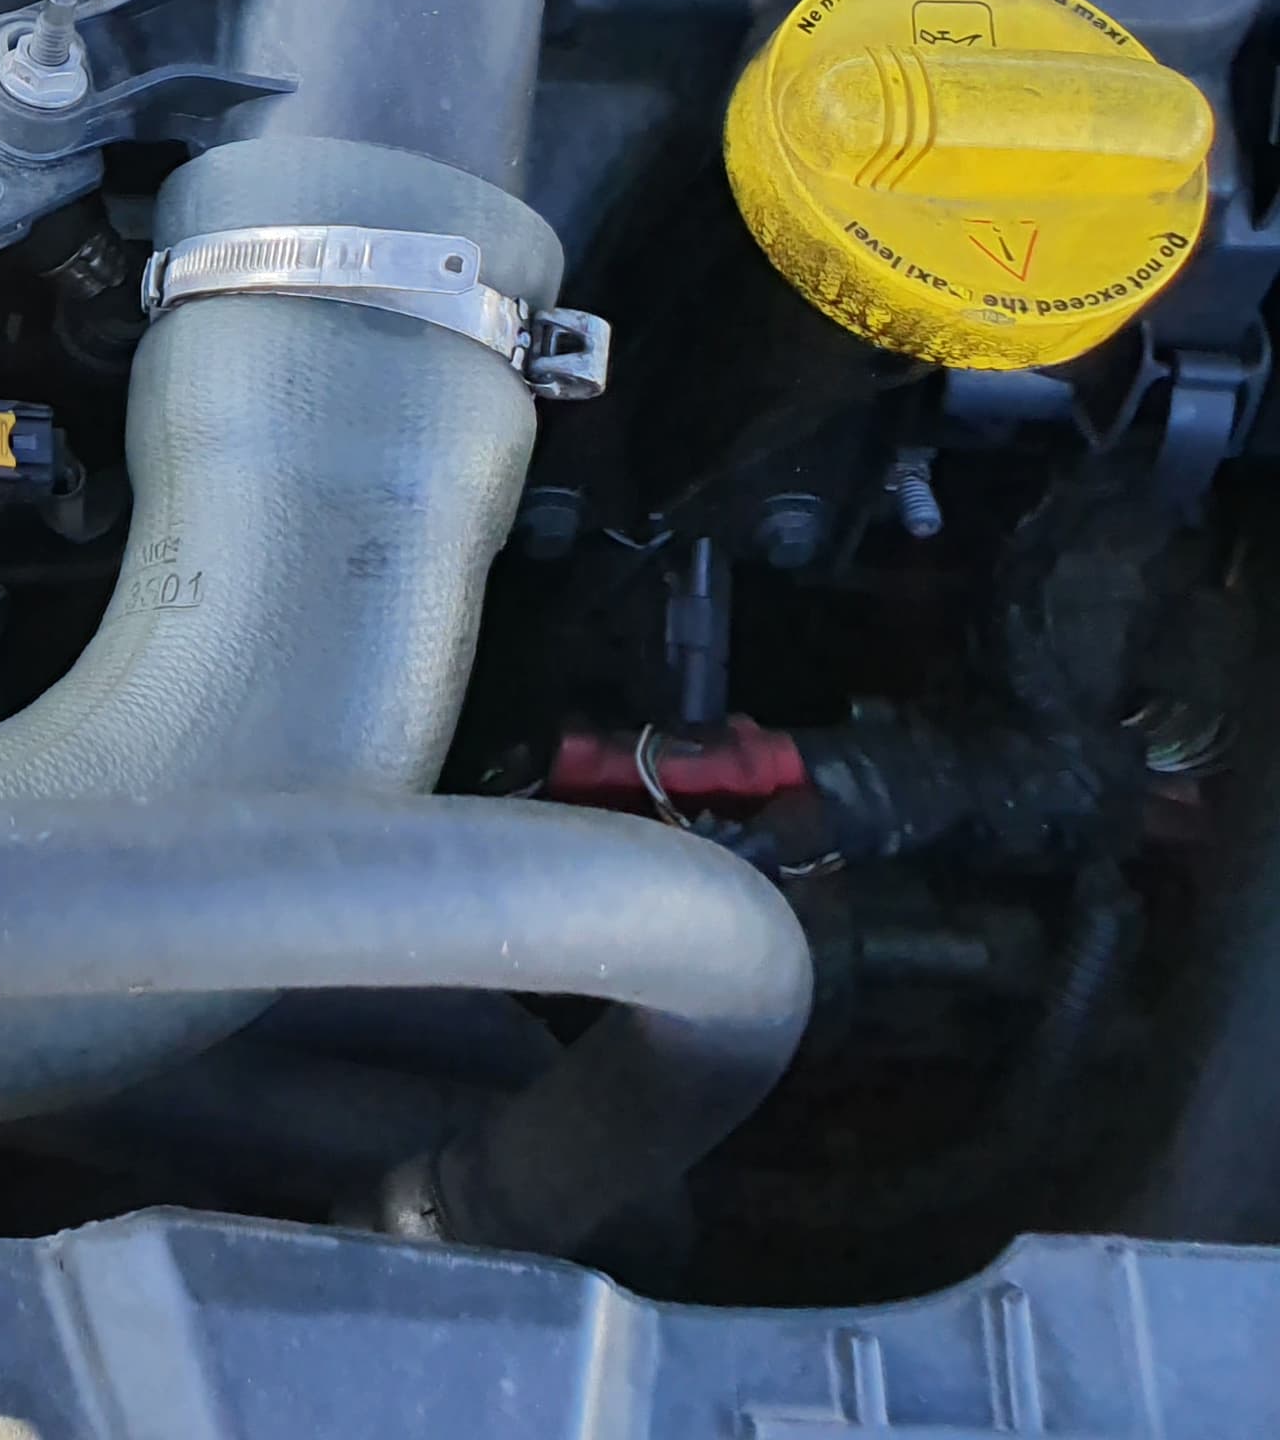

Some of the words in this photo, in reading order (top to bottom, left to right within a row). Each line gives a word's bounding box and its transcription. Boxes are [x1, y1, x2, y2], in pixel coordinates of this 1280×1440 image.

[797, 8, 823, 35] Ne
[1071, 2, 1131, 47] maxi
[843, 220, 904, 270] level
[1156, 231, 1190, 260] Do
[904, 263, 975, 301] axi
[1135, 257, 1166, 290] not
[982, 292, 1029, 315] the
[1035, 281, 1128, 317] exceed
